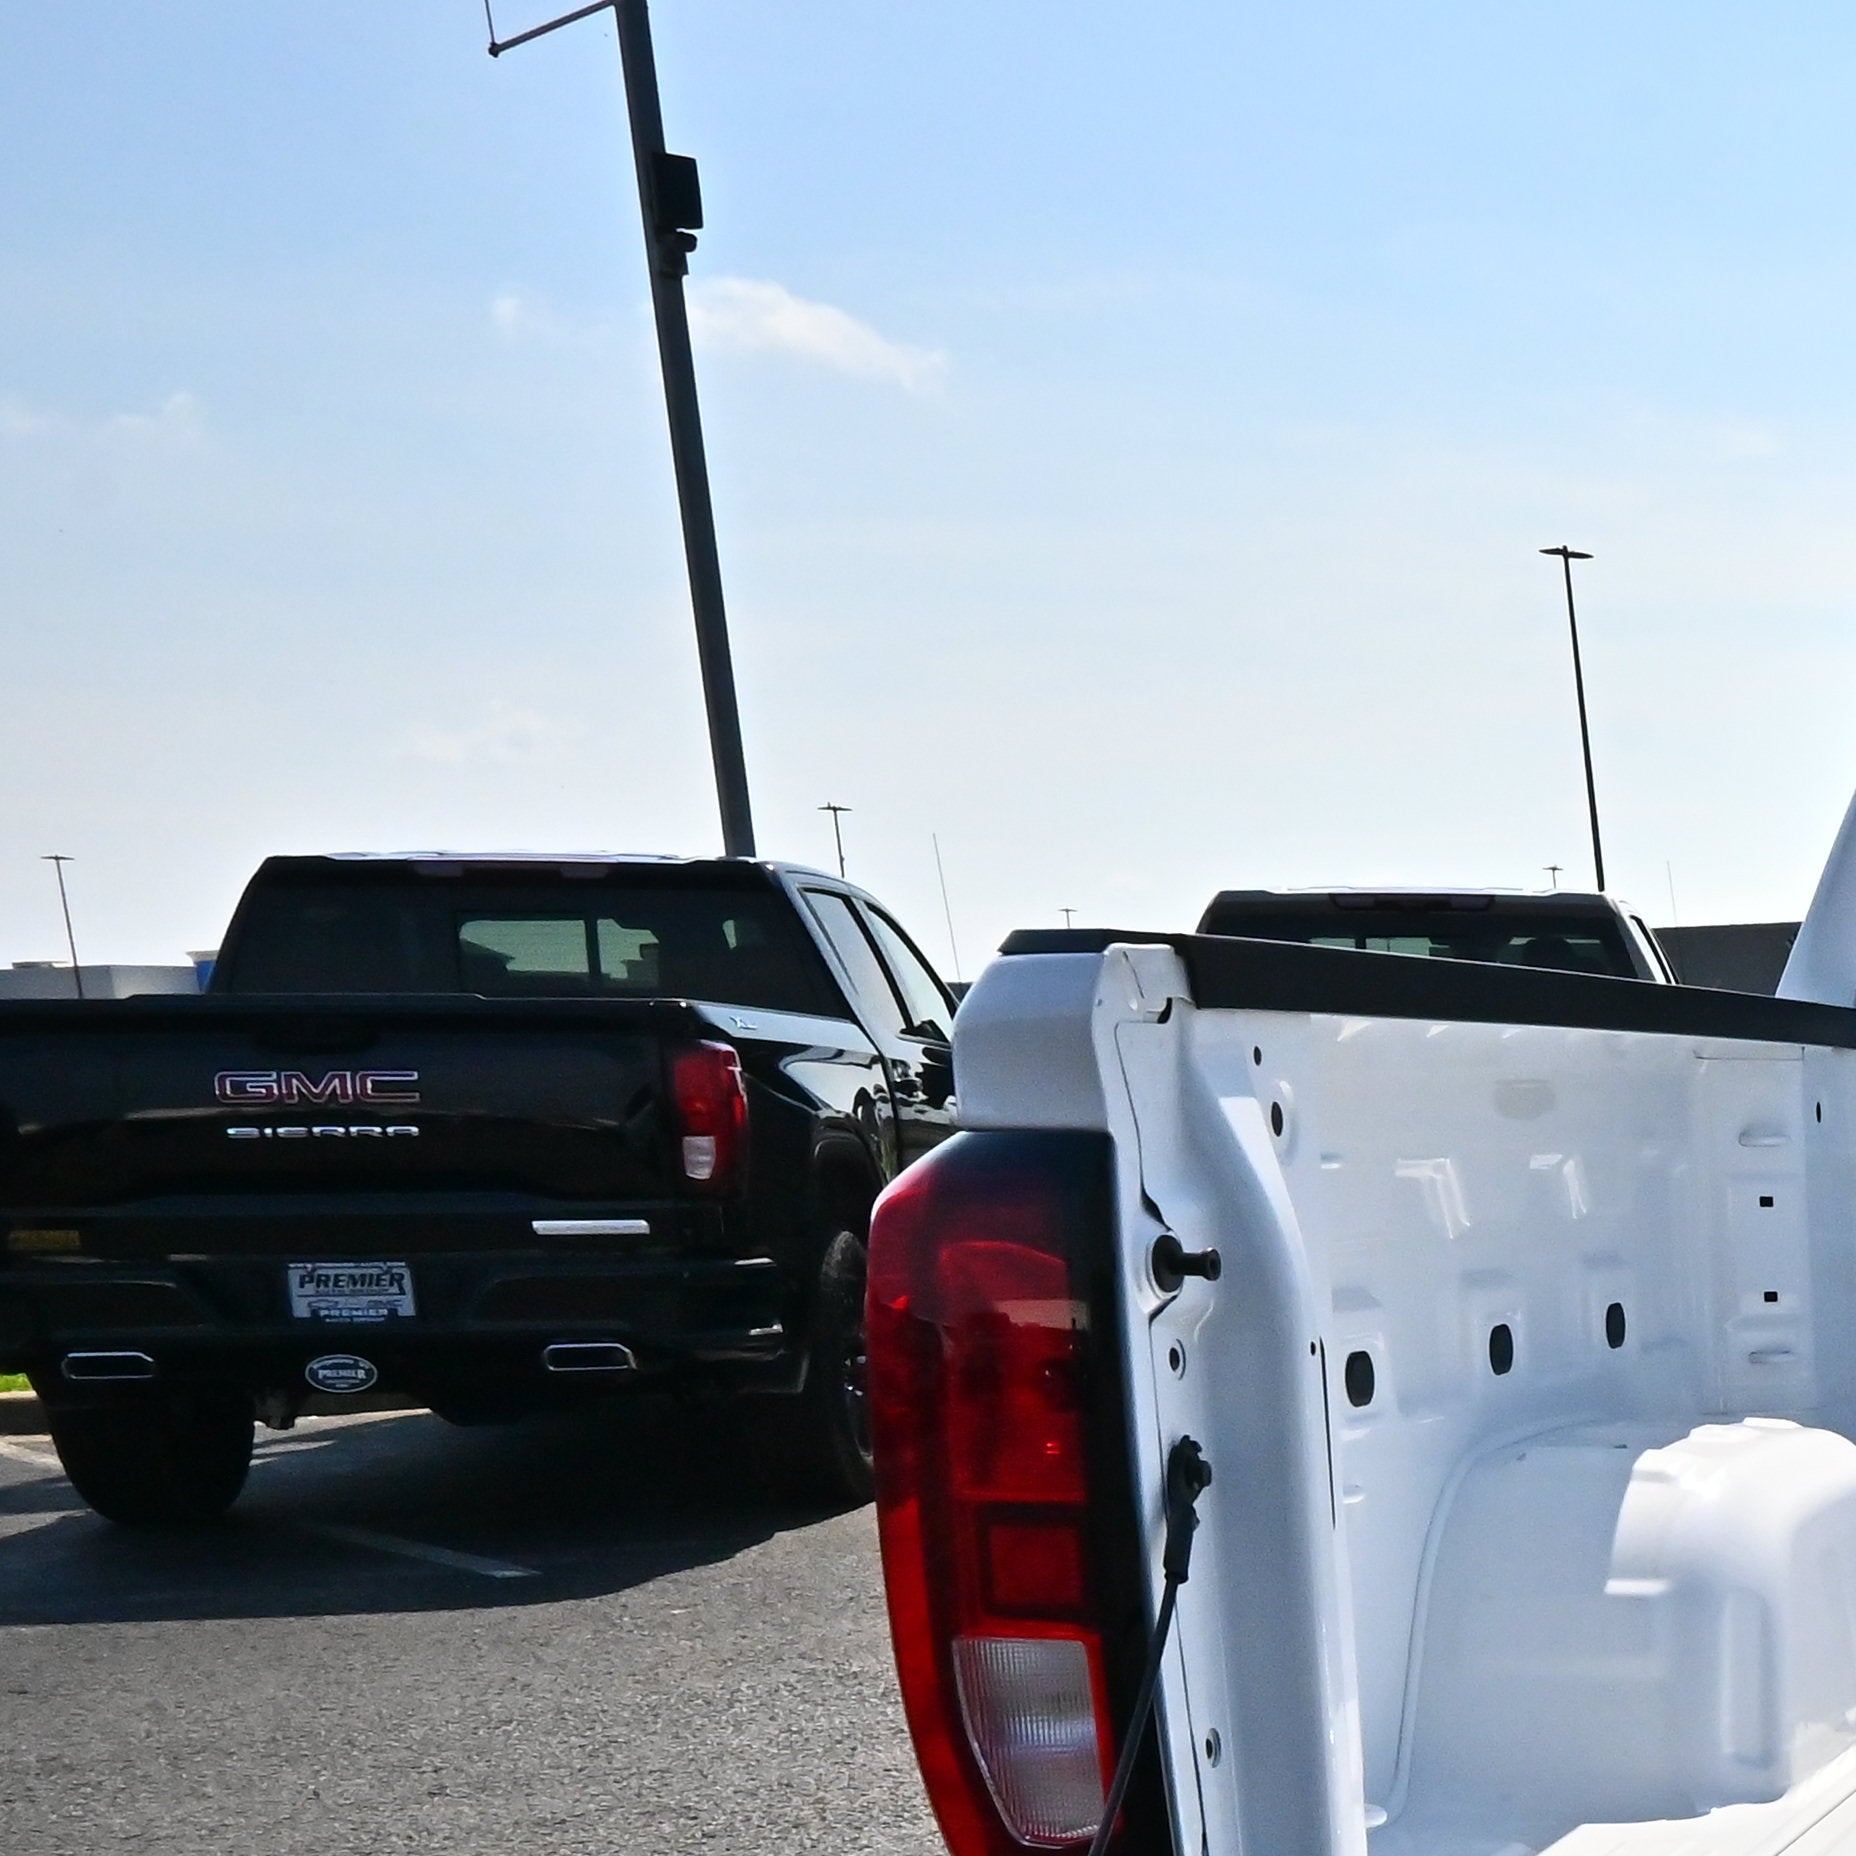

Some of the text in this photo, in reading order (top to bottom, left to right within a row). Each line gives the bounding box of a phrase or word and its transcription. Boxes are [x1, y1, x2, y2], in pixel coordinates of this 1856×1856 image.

[214, 1071, 420, 1104] GMC
[226, 1125, 420, 1139] SIERRA
[298, 1271, 407, 1296] PREMIER
